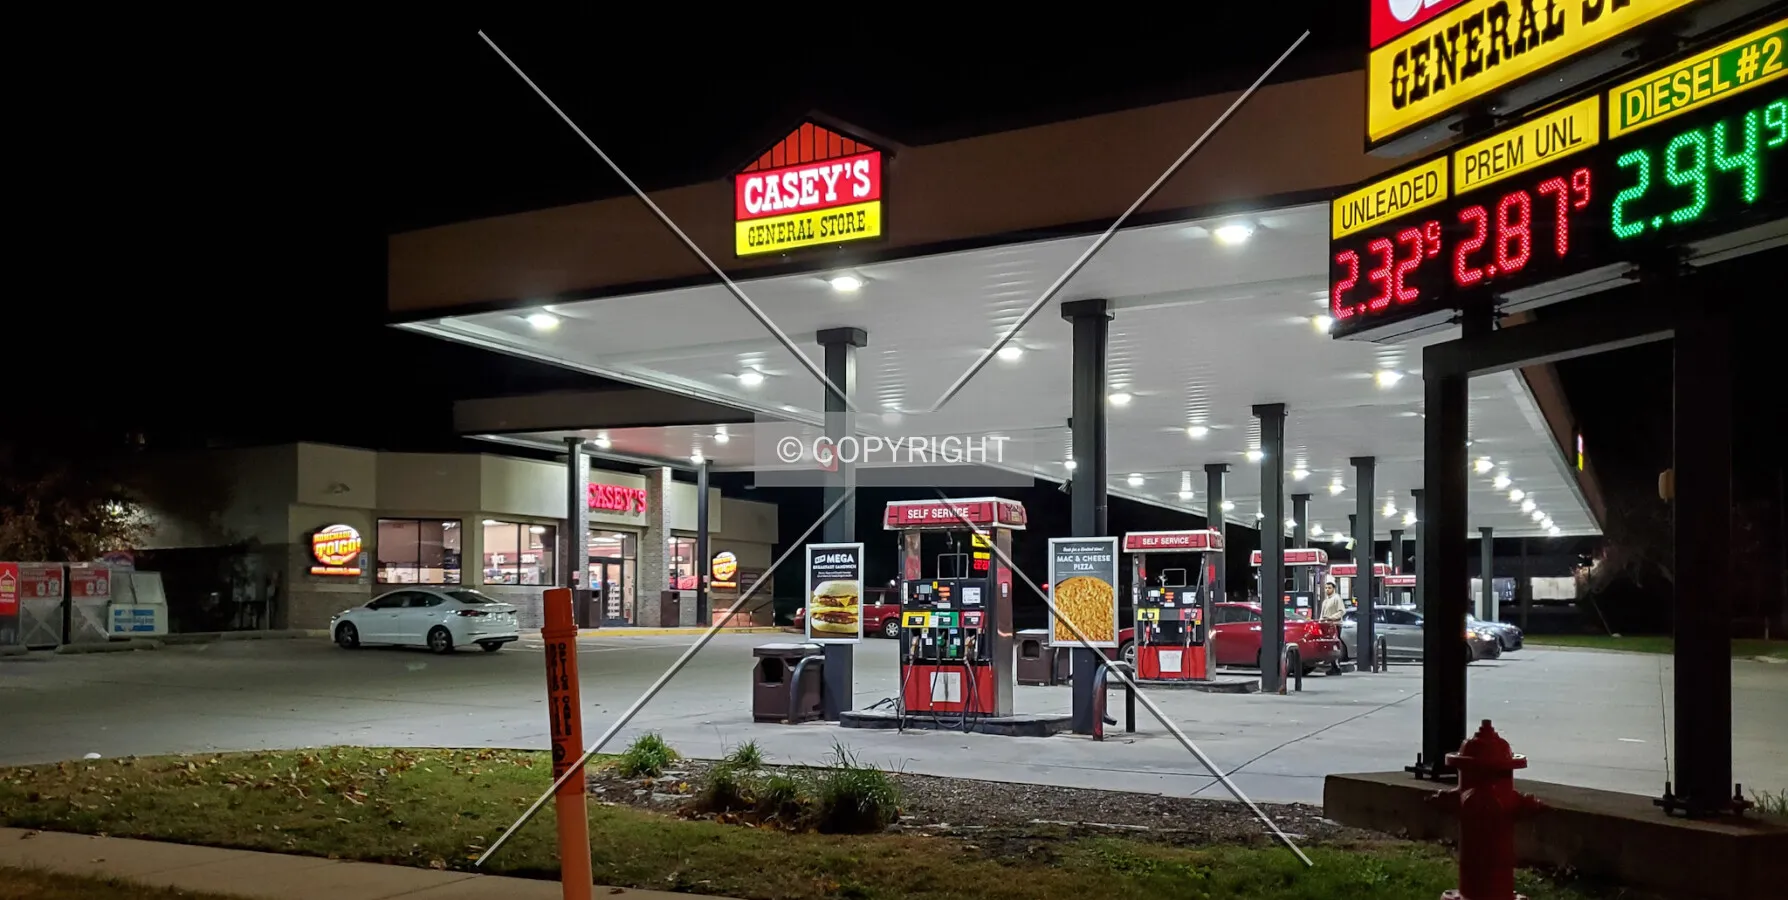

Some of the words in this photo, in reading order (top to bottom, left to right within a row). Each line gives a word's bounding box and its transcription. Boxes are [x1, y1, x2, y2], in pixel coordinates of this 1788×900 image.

[1389, 0, 1565, 110] GENERAL
[1626, 57, 1730, 126] DIESEL
[1736, 36, 1783, 84] #2
[1465, 135, 1524, 185] PREM
[1535, 115, 1582, 158] UNL
[744, 159, 871, 214] CASEY'S
[1342, 170, 1438, 230] UNLEADED
[748, 218, 815, 247] GENERAL
[820, 210, 866, 238] STORE
[587, 483, 648, 513] CASEY'S
[907, 508, 929, 519] SELF
[931, 507, 969, 518] SERVICE
[315, 541, 335, 559] TO
[1142, 537, 1159, 545] SELF
[1160, 536, 1189, 545] SERVICE
[826, 553, 854, 563] MEGA
[1082, 554, 1111, 562] CHEESE
